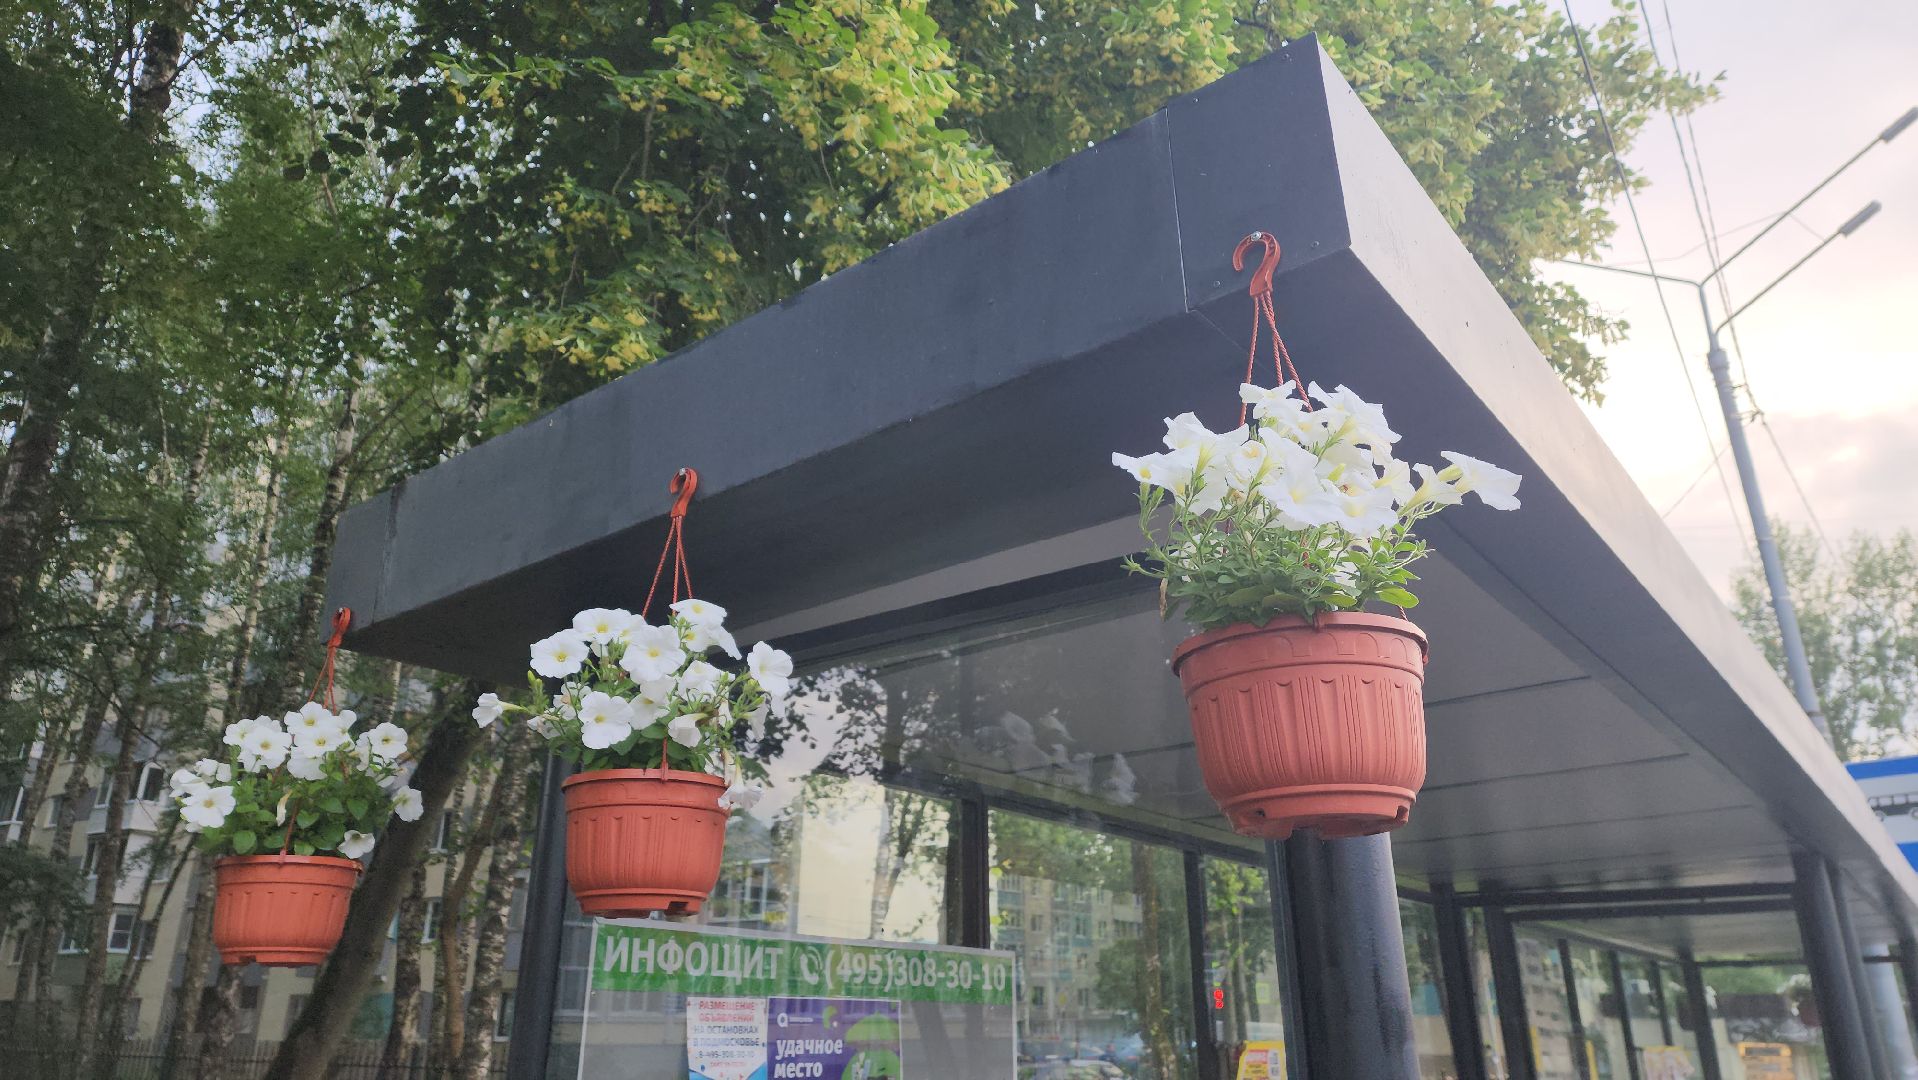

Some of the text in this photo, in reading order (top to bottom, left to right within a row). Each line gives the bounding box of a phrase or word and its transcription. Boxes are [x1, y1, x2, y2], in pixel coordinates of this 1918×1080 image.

[603, 935, 1006, 992] ИНФОЩИТ (495)308-30-10
[707, 1025, 758, 1035] ОСТАНОВКАХ
[775, 1040, 843, 1060] удачное
[774, 1062, 823, 1078] место
